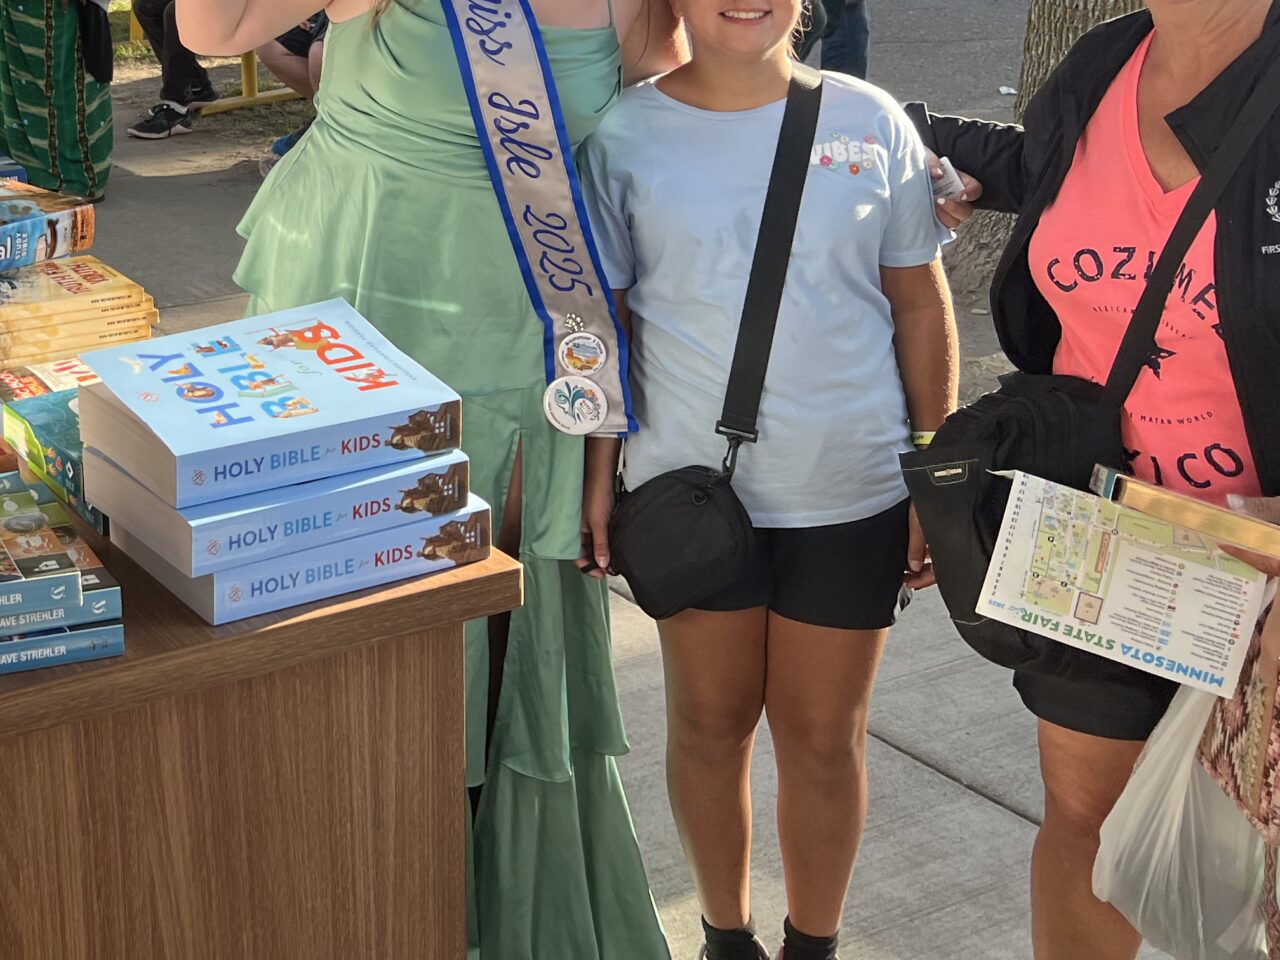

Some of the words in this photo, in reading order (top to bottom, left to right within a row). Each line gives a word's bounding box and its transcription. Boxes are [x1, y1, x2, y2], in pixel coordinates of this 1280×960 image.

[523, 204, 593, 297] 2025
[294, 319, 400, 392] KIDS
[137, 351, 256, 429] HOLY
[1176, 411, 1214, 424] WORLD
[214, 456, 265, 481] HOLY
[270, 446, 320, 472] BIBLE
[324, 446, 337, 457] for
[341, 433, 381, 455] KIDS
[228, 524, 277, 550] HOLY
[284, 511, 333, 537] BIBLE
[336, 511, 349, 523] for
[352, 497, 392, 519] KIDS
[250, 572, 298, 597] HOLY
[305, 558, 355, 584] BIBLE
[358, 559, 371, 570] for
[374, 544, 413, 567] KIDS
[19, 608, 65, 625] STREHLER
[1020, 607, 1060, 632] FAIR
[1063, 625, 1116, 651] STATE
[20, 646, 67, 662] STREHLER
[1121, 643, 1225, 688] MINNESOTA
